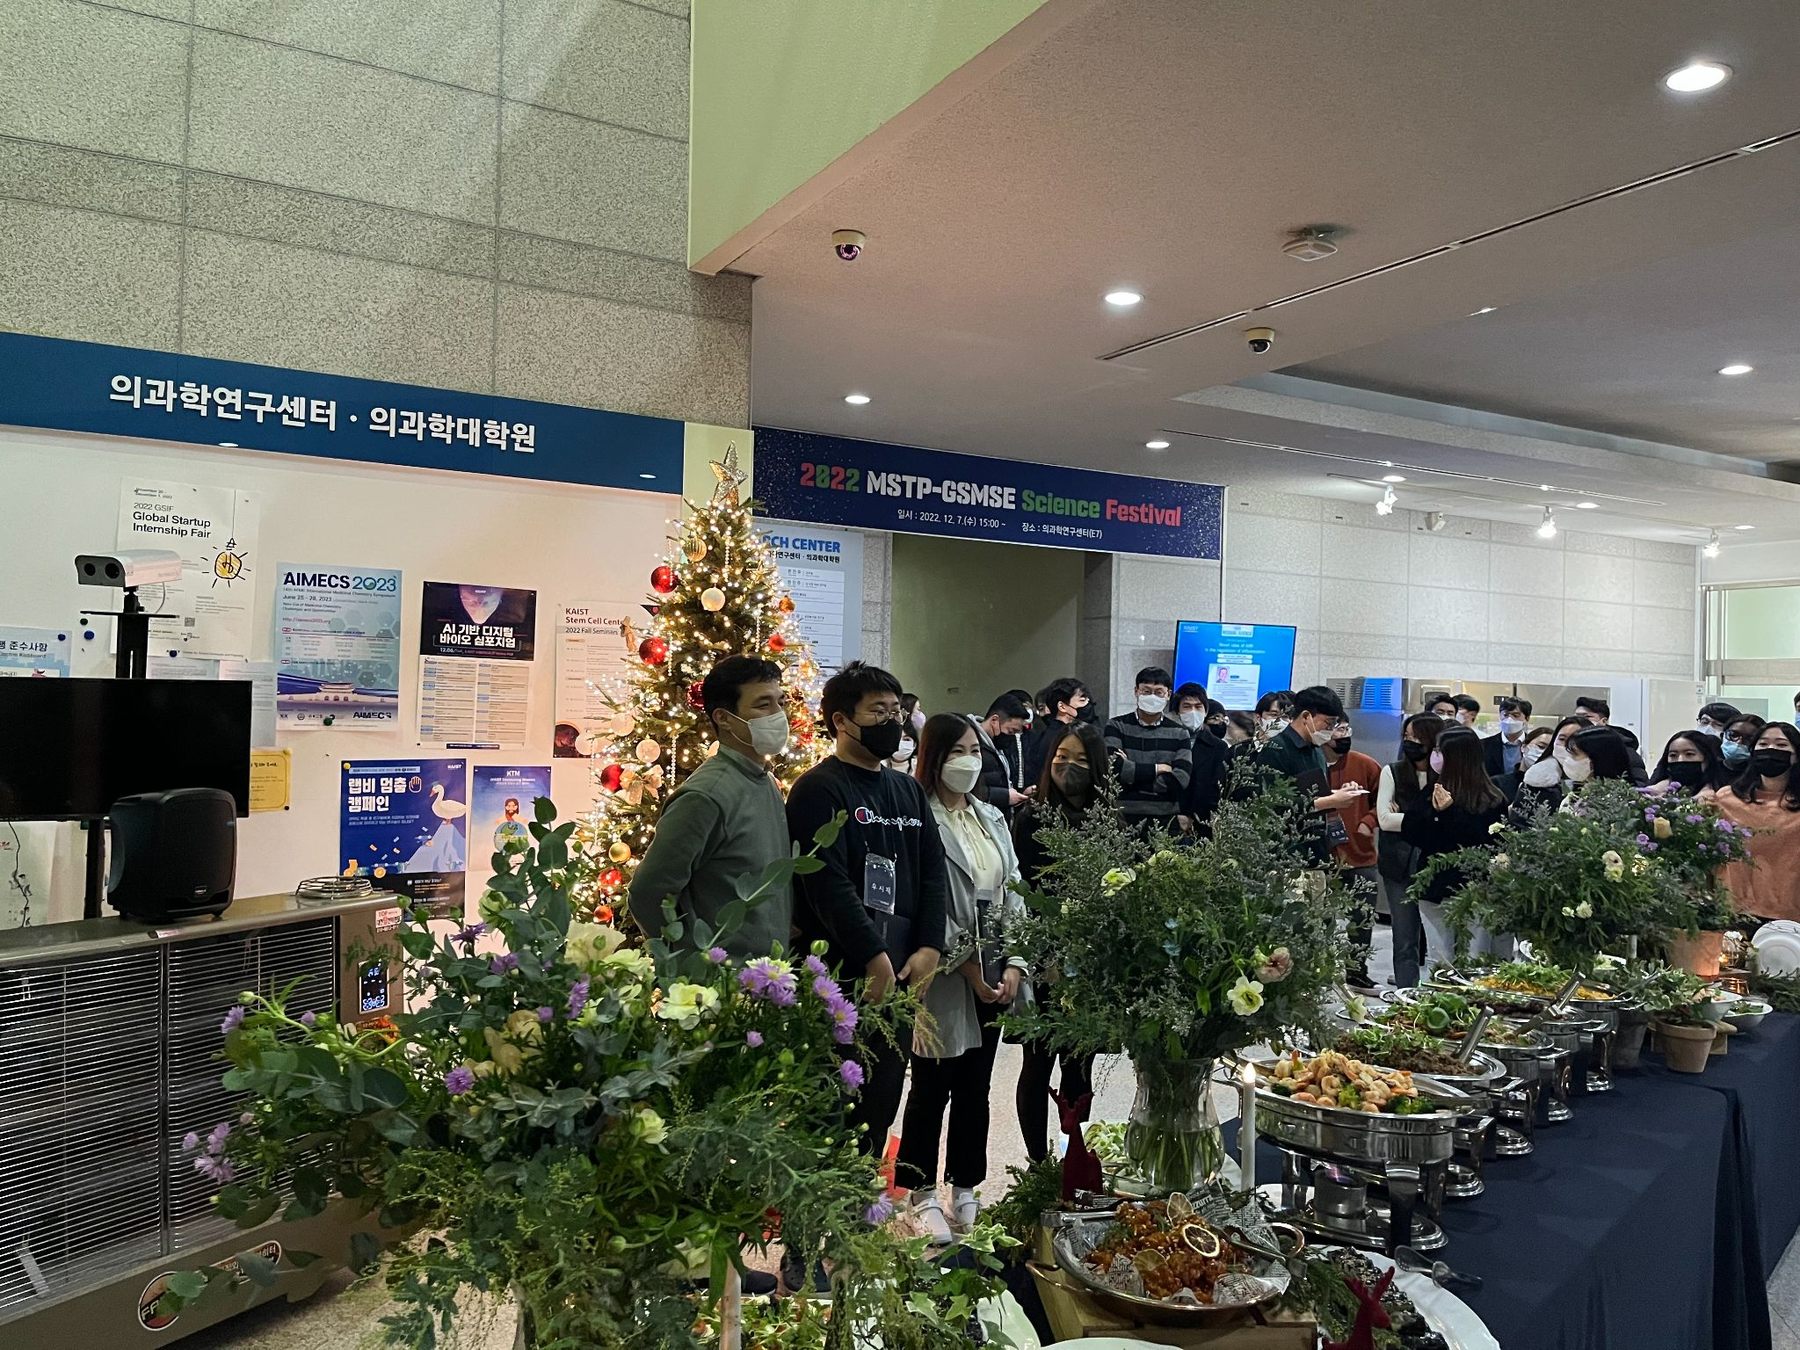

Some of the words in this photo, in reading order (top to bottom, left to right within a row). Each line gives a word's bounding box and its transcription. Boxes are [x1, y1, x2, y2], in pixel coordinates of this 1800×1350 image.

[110, 373, 337, 432] 의과학연구센터
[369, 406, 536, 455] 의과학대학원
[800, 462, 860, 493] 2022
[866, 470, 1016, 511] MSTP-GSMSE
[1021, 489, 1101, 520] Science
[1105, 498, 1182, 528] Festival
[133, 502, 153, 512] 2022
[154, 504, 174, 512] GSIF
[132, 511, 169, 524] Global
[172, 515, 211, 529] Startup
[897, 509, 913, 520] 일시
[919, 511, 941, 523] 2022.
[979, 517, 1000, 528] 15:00
[132, 522, 188, 538] Internship
[190, 528, 212, 539] Fair
[1021, 522, 1036, 533] 장소
[1041, 524, 1103, 539] 의과학연구센터(E7)
[792, 538, 841, 553] CENTER
[283, 571, 350, 589] AIMECS
[352, 575, 396, 592] 2023
[565, 608, 589, 616] KAIST
[565, 616, 586, 624] Stem
[587, 617, 602, 625] Cell
[603, 618, 624, 626] Cente
[442, 623, 456, 633] AI
[458, 624, 480, 635] 기반
[482, 626, 513, 638] 디지털
[565, 626, 580, 634] 2022
[9, 640, 48, 652] 준수사항
[439, 633, 471, 645] 바이오
[474, 635, 516, 648] 심포지엄
[348, 777, 376, 795] 랩비
[380, 776, 407, 794] 멈춤
[347, 795, 389, 813] 캠페인
[855, 806, 923, 832] Champion
